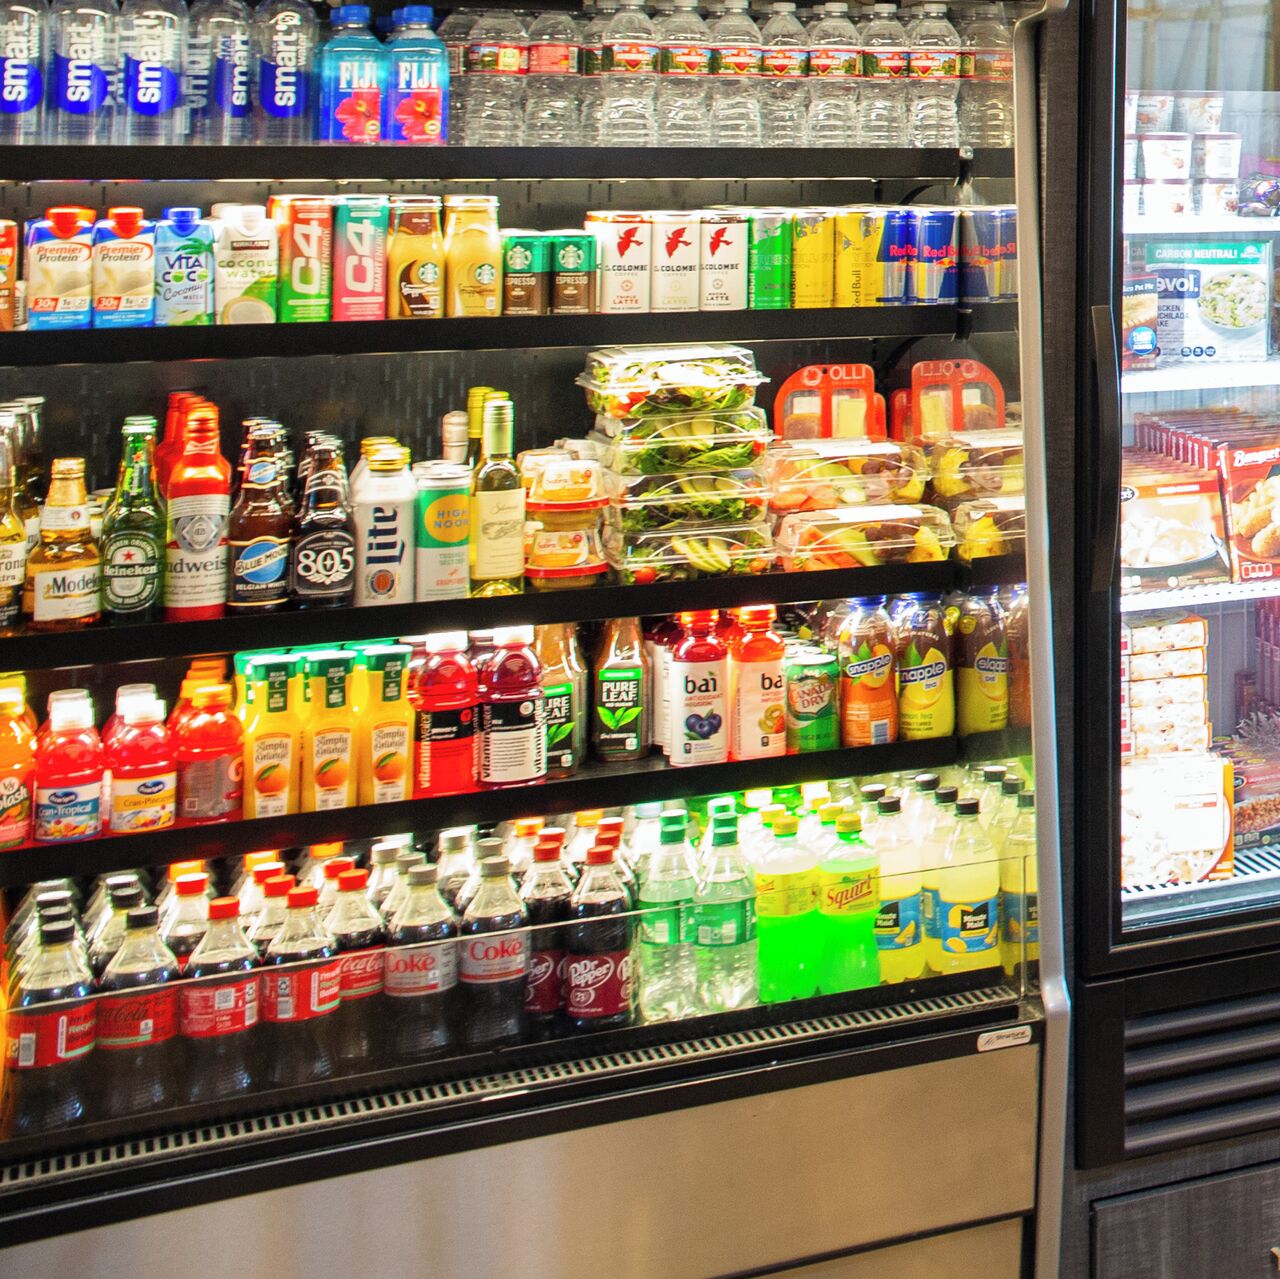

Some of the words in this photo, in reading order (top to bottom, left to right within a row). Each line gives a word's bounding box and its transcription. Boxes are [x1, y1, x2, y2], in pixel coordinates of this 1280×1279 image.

[339, 61, 378, 89] FIJI
[398, 61, 438, 89] FIJI
[37, 245, 83, 255] Premier
[99, 245, 144, 255] Premier
[292, 220, 323, 294] C4
[345, 219, 376, 293] C4
[1155, 249, 1192, 259] CARBON
[1194, 248, 1238, 259] NEUTRAL!
[38, 253, 79, 263] Protein
[100, 253, 140, 263] Protein
[165, 256, 205, 270] VITA
[830, 366, 866, 380] OLLI
[297, 547, 355, 576] 805
[104, 564, 159, 577] Heineken
[850, 654, 892, 675] snapple
[602, 681, 638, 692] PURE
[685, 671, 717, 694] bai
[801, 696, 826, 709] DRY
[470, 940, 522, 962] Coke
[571, 965, 611, 988] Pepper
